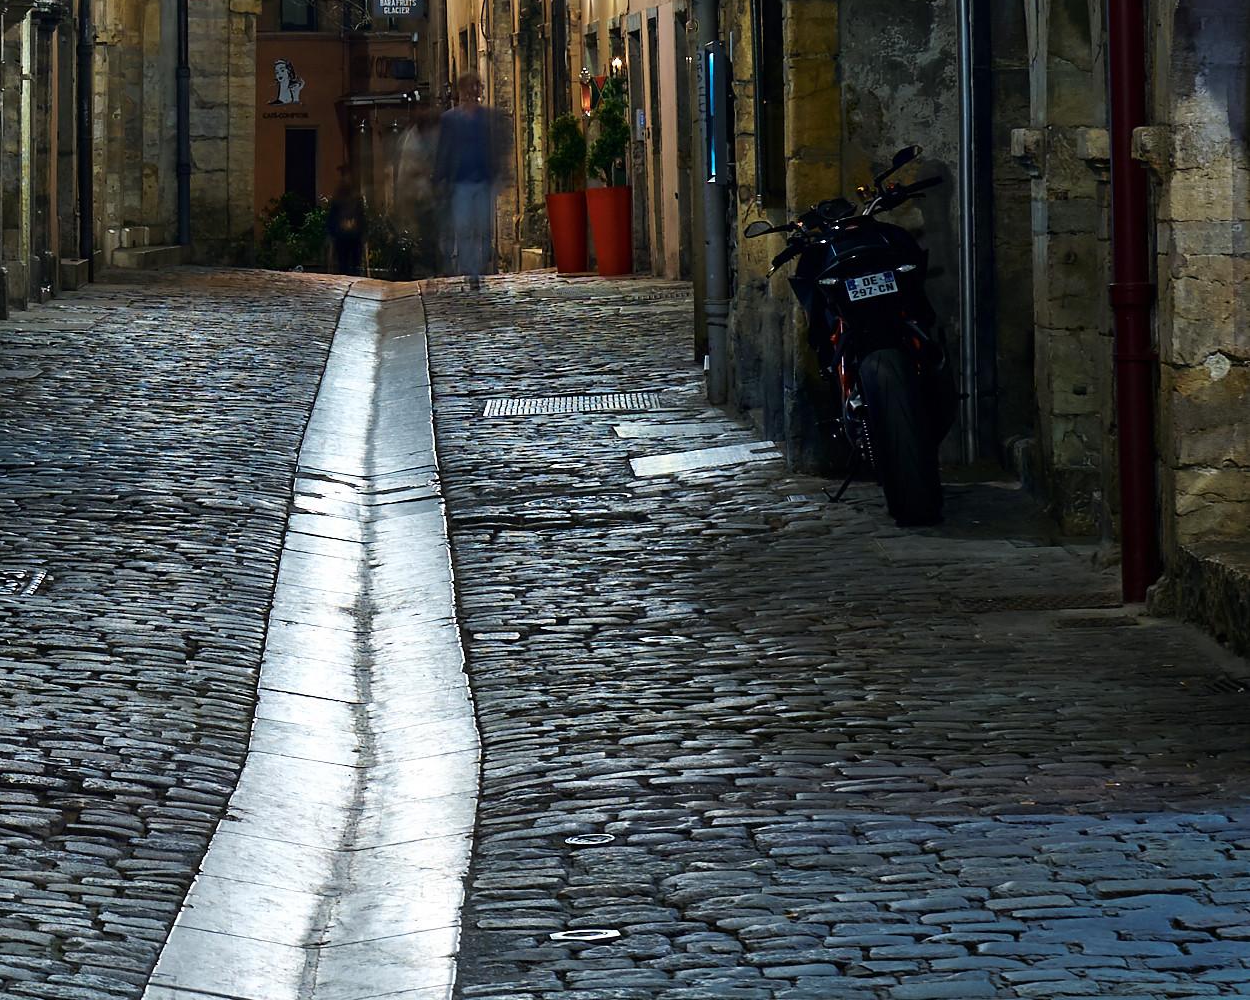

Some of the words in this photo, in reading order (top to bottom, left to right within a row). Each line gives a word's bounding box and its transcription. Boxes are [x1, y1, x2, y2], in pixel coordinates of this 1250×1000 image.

[396, 0, 417, 7] FRUITS
[383, 6, 410, 14] GLACIER
[862, 276, 878, 287] DE
[852, 283, 895, 299] 297-CN
